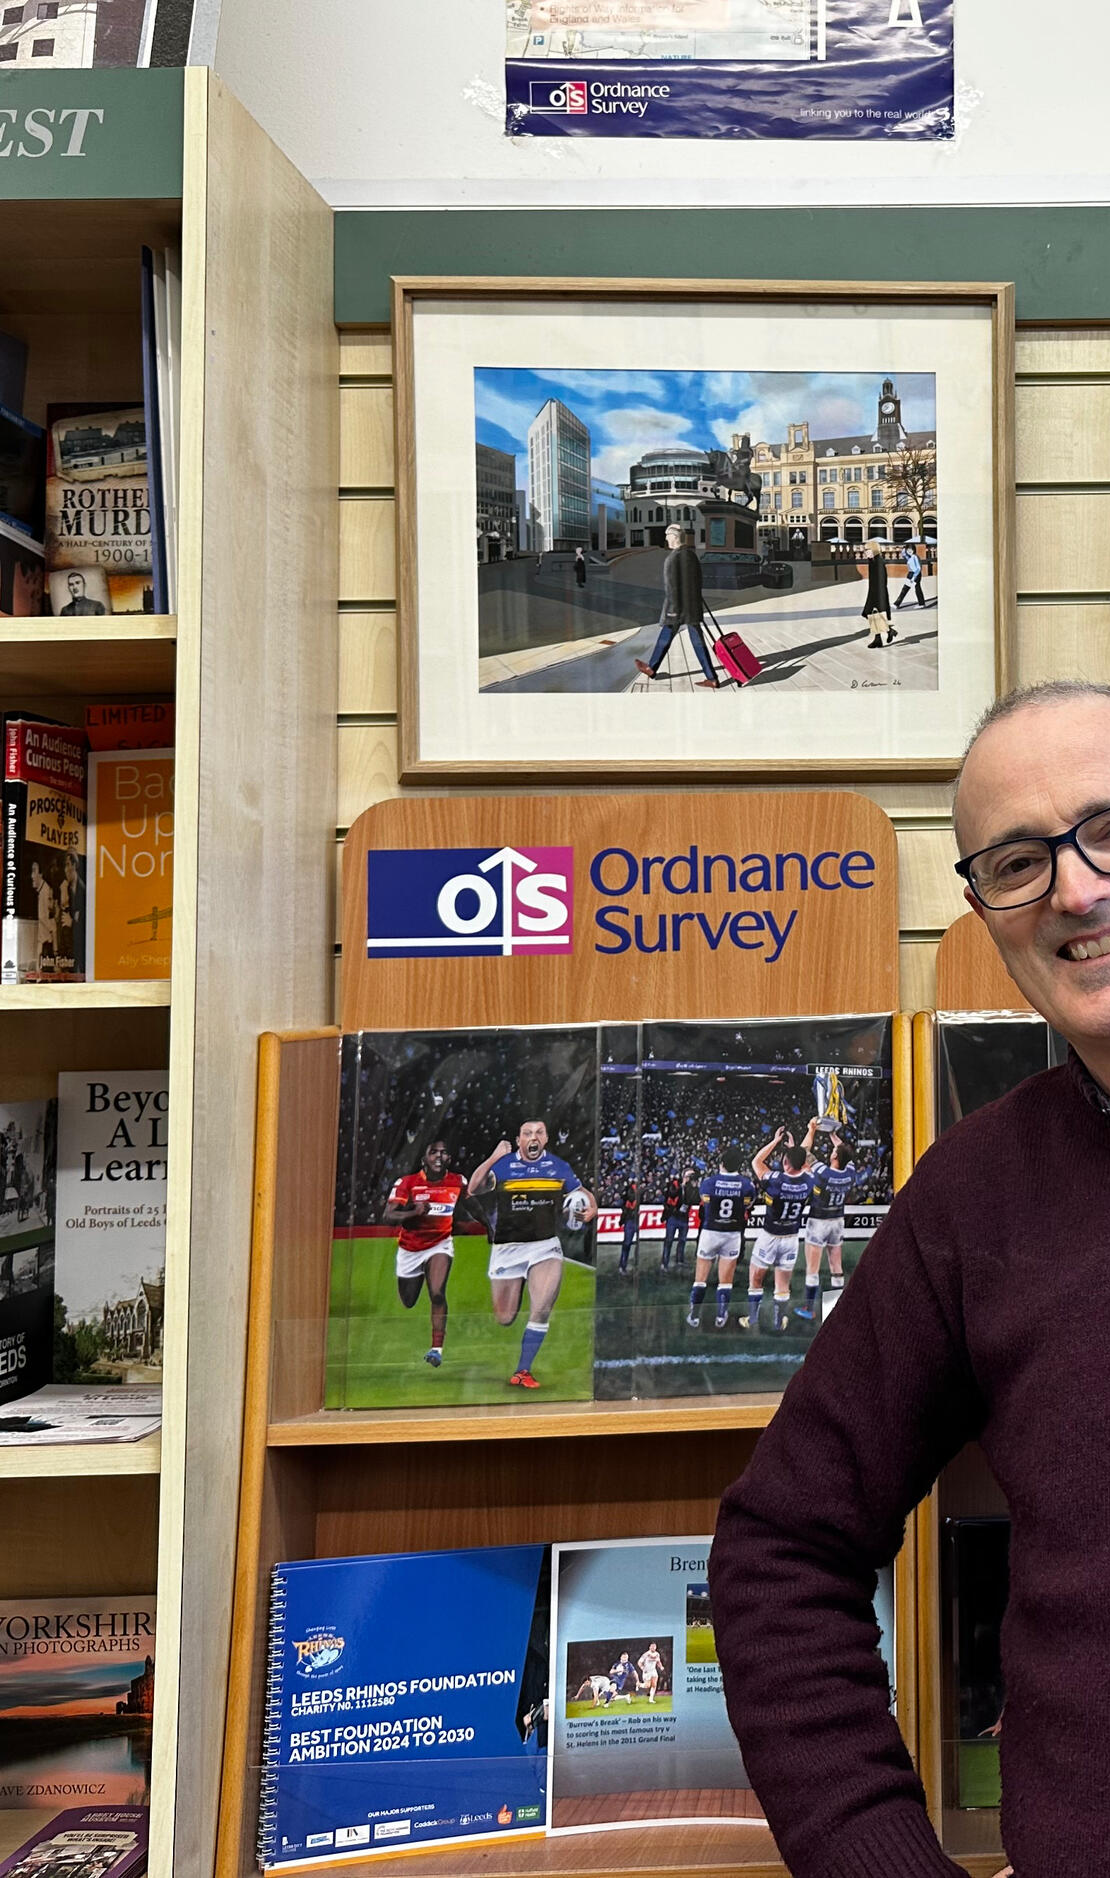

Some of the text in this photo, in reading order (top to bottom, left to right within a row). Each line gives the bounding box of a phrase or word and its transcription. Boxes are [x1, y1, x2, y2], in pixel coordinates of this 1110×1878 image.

[550, 15, 590, 25] England
[590, 82, 670, 98] Ordnance
[592, 100, 648, 117] Survey
[800, 108, 832, 120] linking
[834, 110, 851, 120] you
[854, 109, 864, 118] to
[866, 109, 882, 119] the
[884, 109, 902, 119] real
[62, 488, 149, 509] ROTHE
[67, 540, 133, 548] HALF-CENTURY
[135, 539, 147, 547] OF
[87, 705, 166, 726] LIMITED
[9, 728, 18, 773] John Fisher
[25, 729, 82, 759] An Audience
[26, 749, 61, 773] Curious
[8, 803, 17, 816] An
[122, 804, 174, 846] Up
[8, 818, 17, 859] Audience
[41, 823, 79, 845] PLAYERS
[7, 861, 16, 870] of
[590, 845, 875, 896] Ordnance
[6, 873, 16, 907] Curious
[594, 905, 798, 963] Survey
[118, 954, 139, 968] Ally
[842, 1067, 874, 1077] RHINOS
[106, 1118, 136, 1148] A
[85, 1203, 160, 1217] Portraits of 25
[719, 1198, 733, 1218] 8
[780, 1202, 802, 1219] 13
[66, 1217, 161, 1231] Old Boys of Leeds
[853, 1216, 884, 1226] 2015
[670, 1556, 708, 1571] Bren
[0, 1612, 156, 1641] ORKSHIR
[13, 1638, 140, 1655] PHOTOGRAPHS
[292, 1669, 516, 1708] LEEDS RHINOS FOUNDATION
[686, 1676, 706, 1684] taking
[291, 1703, 336, 1717] CHARITY
[355, 1696, 396, 1709] 1112580
[663, 1716, 677, 1725] way
[290, 1716, 443, 1747] BEST FOUNDATION
[575, 1730, 599, 1738] scoring
[629, 1726, 654, 1734] famous
[655, 1726, 665, 1734] try
[289, 1727, 475, 1763] AMBITION 2024 TO 2030
[27, 1783, 106, 1796] ZDANOWICZ
[380, 1808, 400, 1816] MAJOR
[400, 1804, 435, 1814] SUPPORTERS
